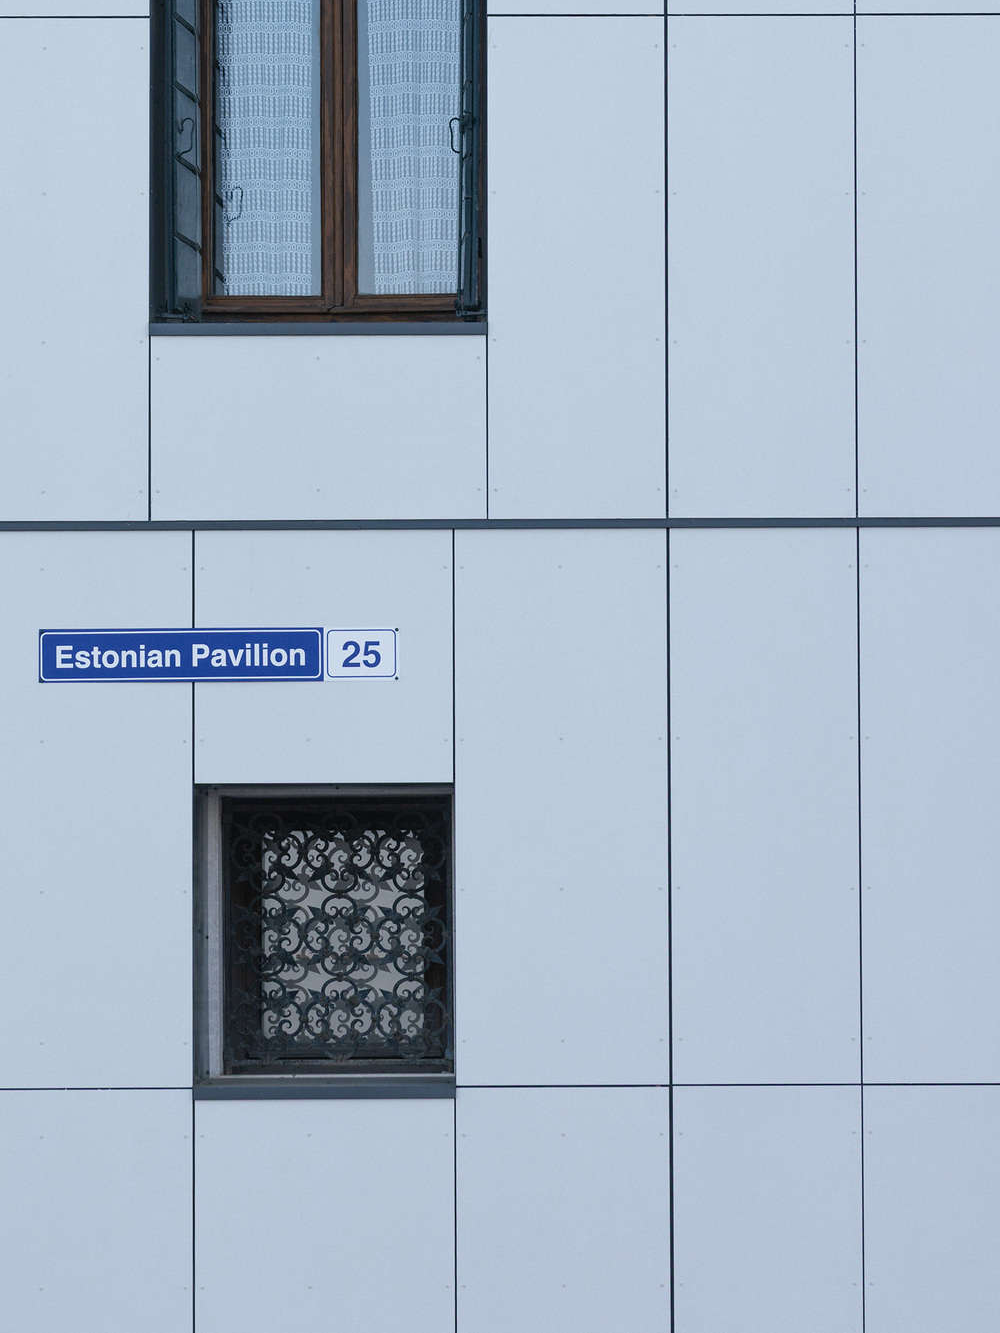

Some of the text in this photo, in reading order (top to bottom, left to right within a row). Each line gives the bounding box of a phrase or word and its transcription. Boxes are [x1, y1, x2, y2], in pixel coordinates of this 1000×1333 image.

[55, 642, 306, 669] Estonian Pavilion
[341, 640, 382, 668] 25
